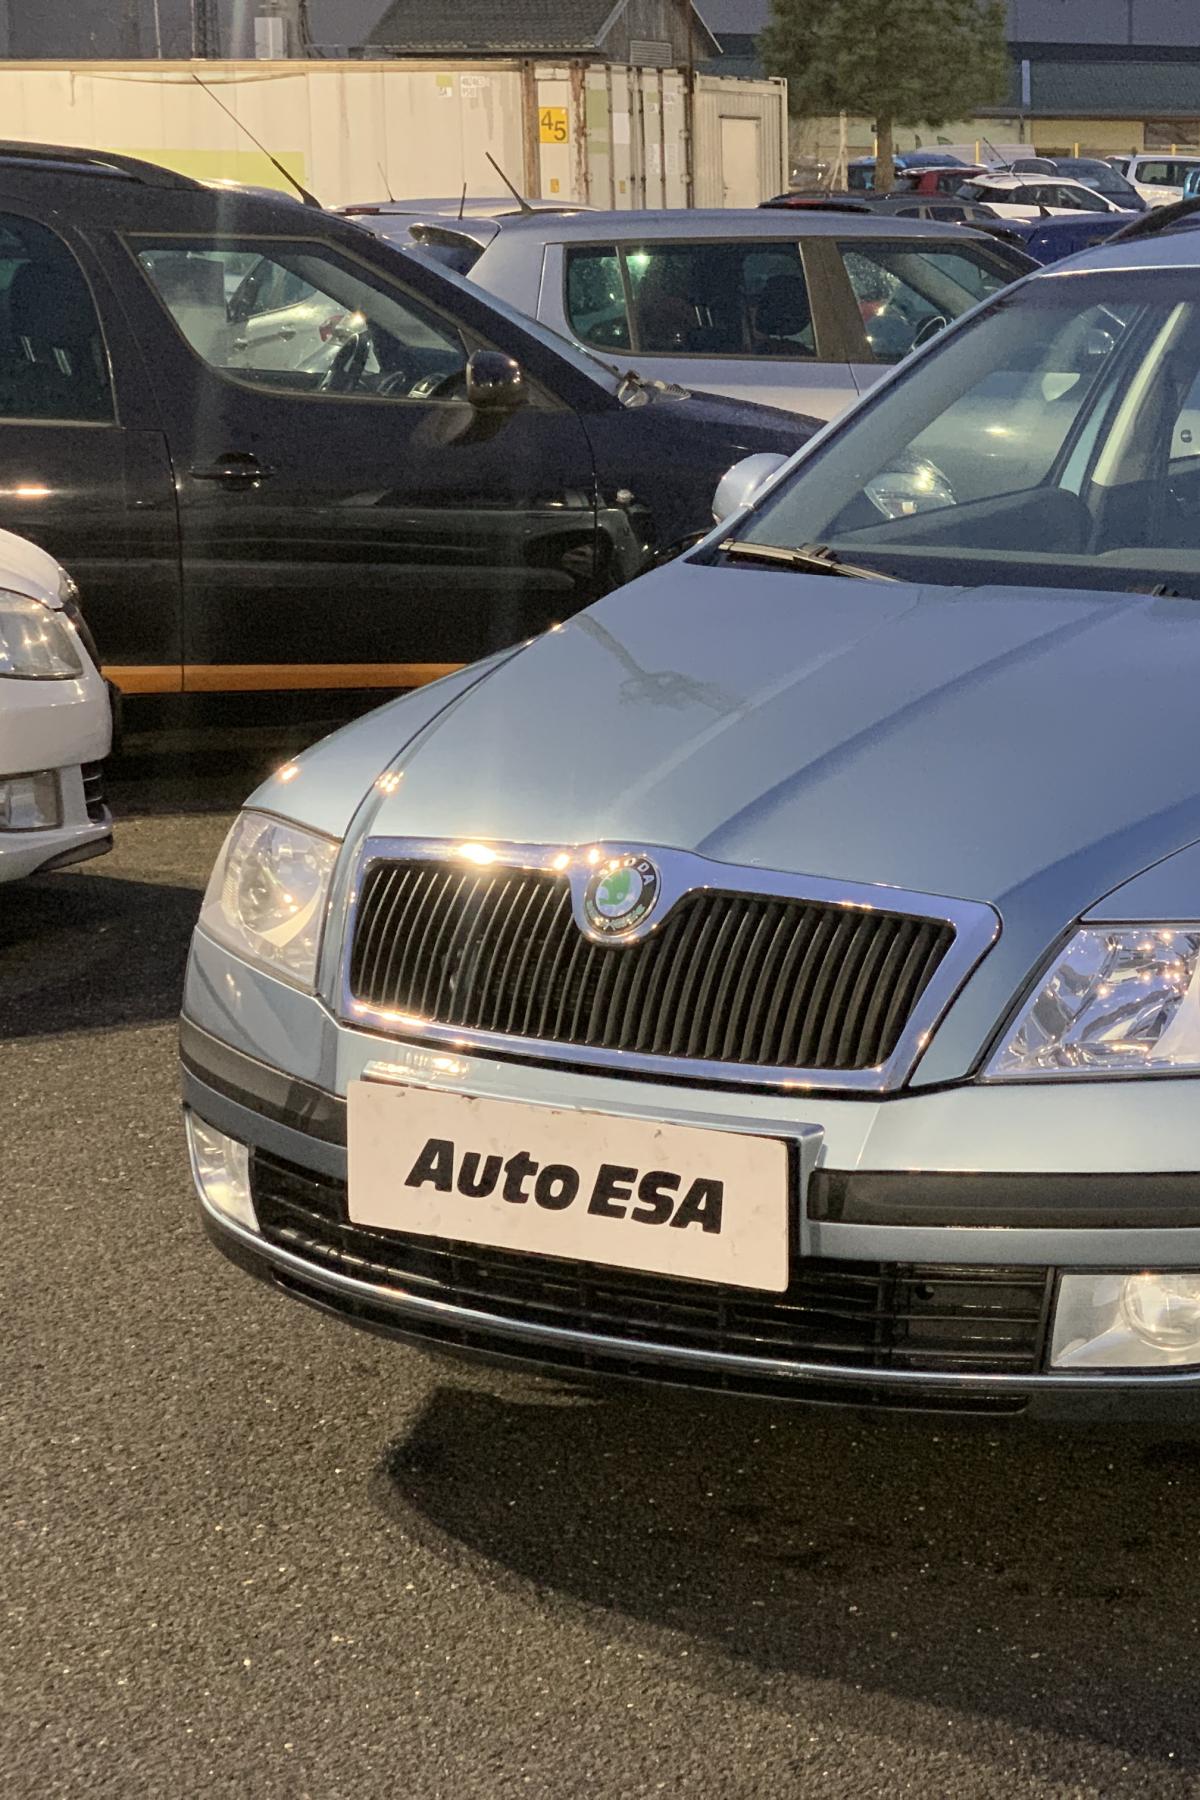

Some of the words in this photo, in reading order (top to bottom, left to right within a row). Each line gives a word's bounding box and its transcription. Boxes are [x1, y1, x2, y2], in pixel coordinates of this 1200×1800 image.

[540, 109, 567, 142] 45
[404, 1138, 580, 1211] Auto
[587, 1163, 724, 1234] ESA
